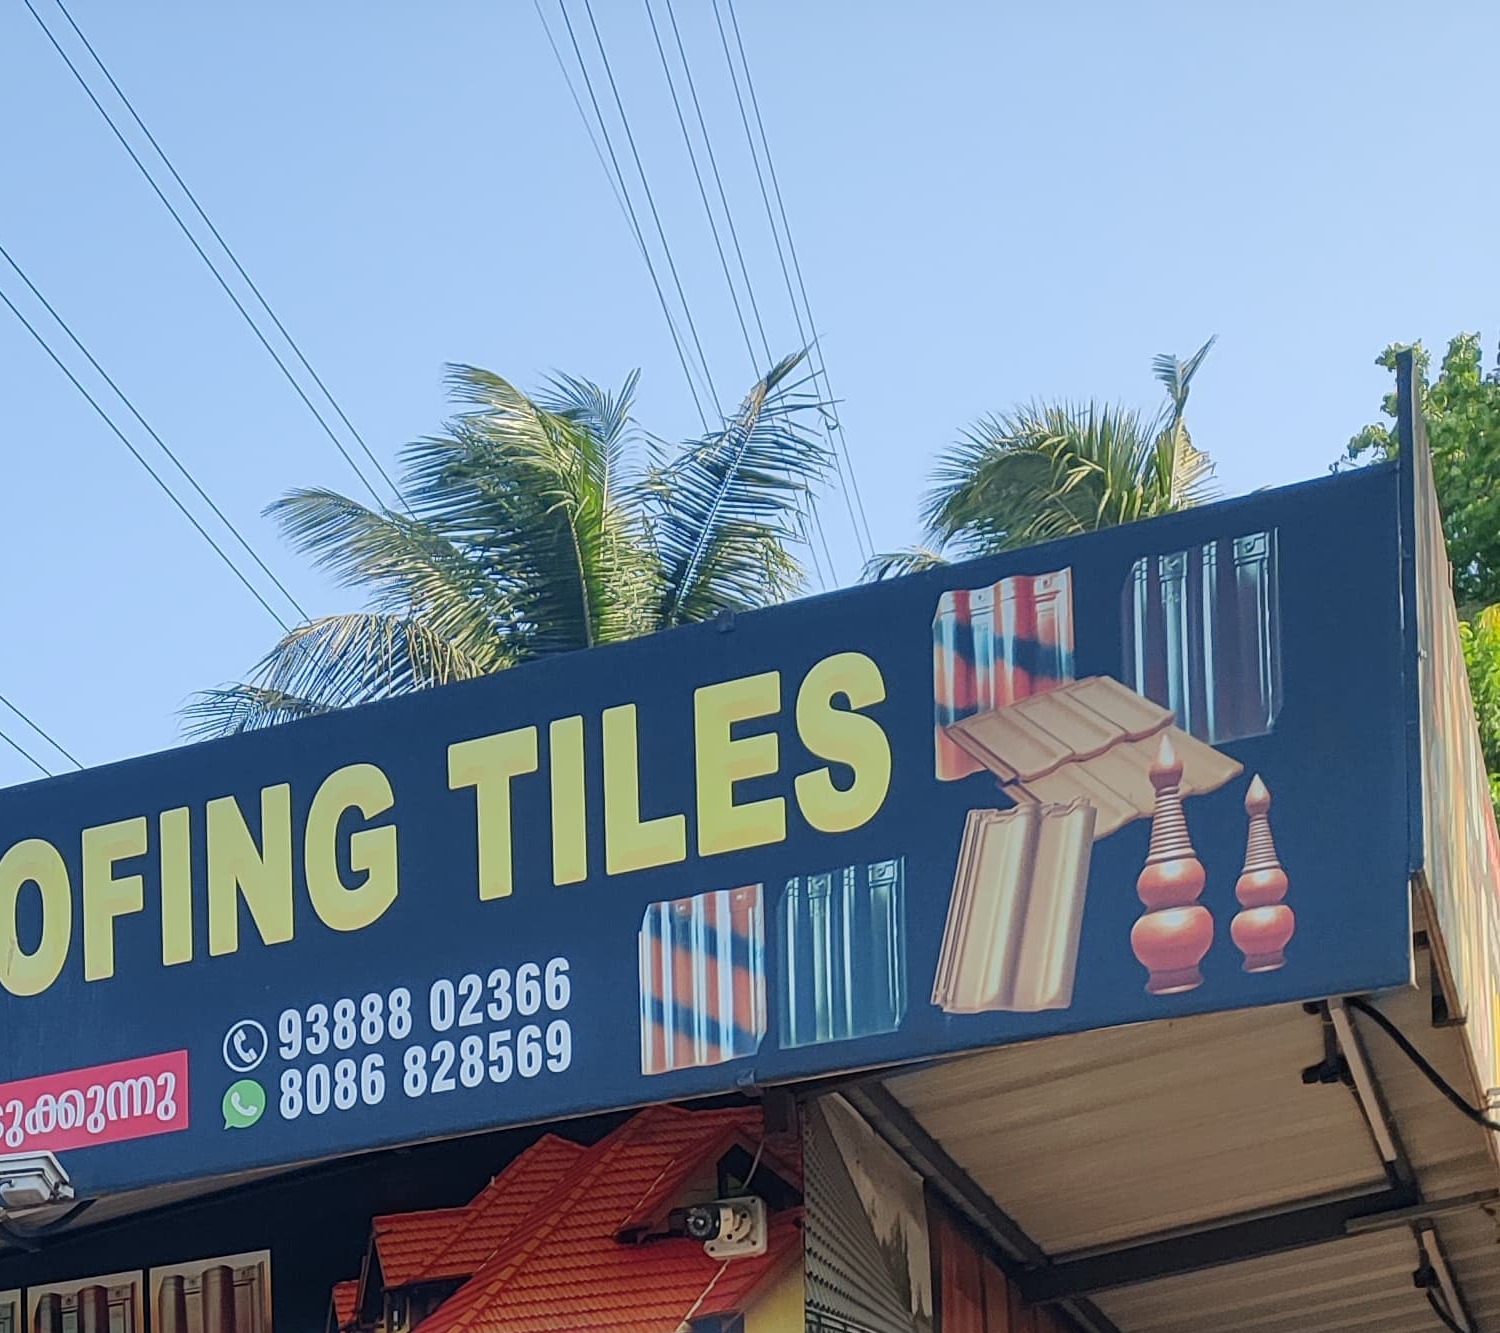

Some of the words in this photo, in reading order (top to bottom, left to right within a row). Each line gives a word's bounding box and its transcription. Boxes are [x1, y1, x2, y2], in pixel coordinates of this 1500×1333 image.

[448, 652, 891, 901] TILES
[278, 987, 412, 1060] 93888
[429, 956, 571, 1032] 02366
[279, 1053, 386, 1120] 8086
[403, 1019, 572, 1098] 828569
